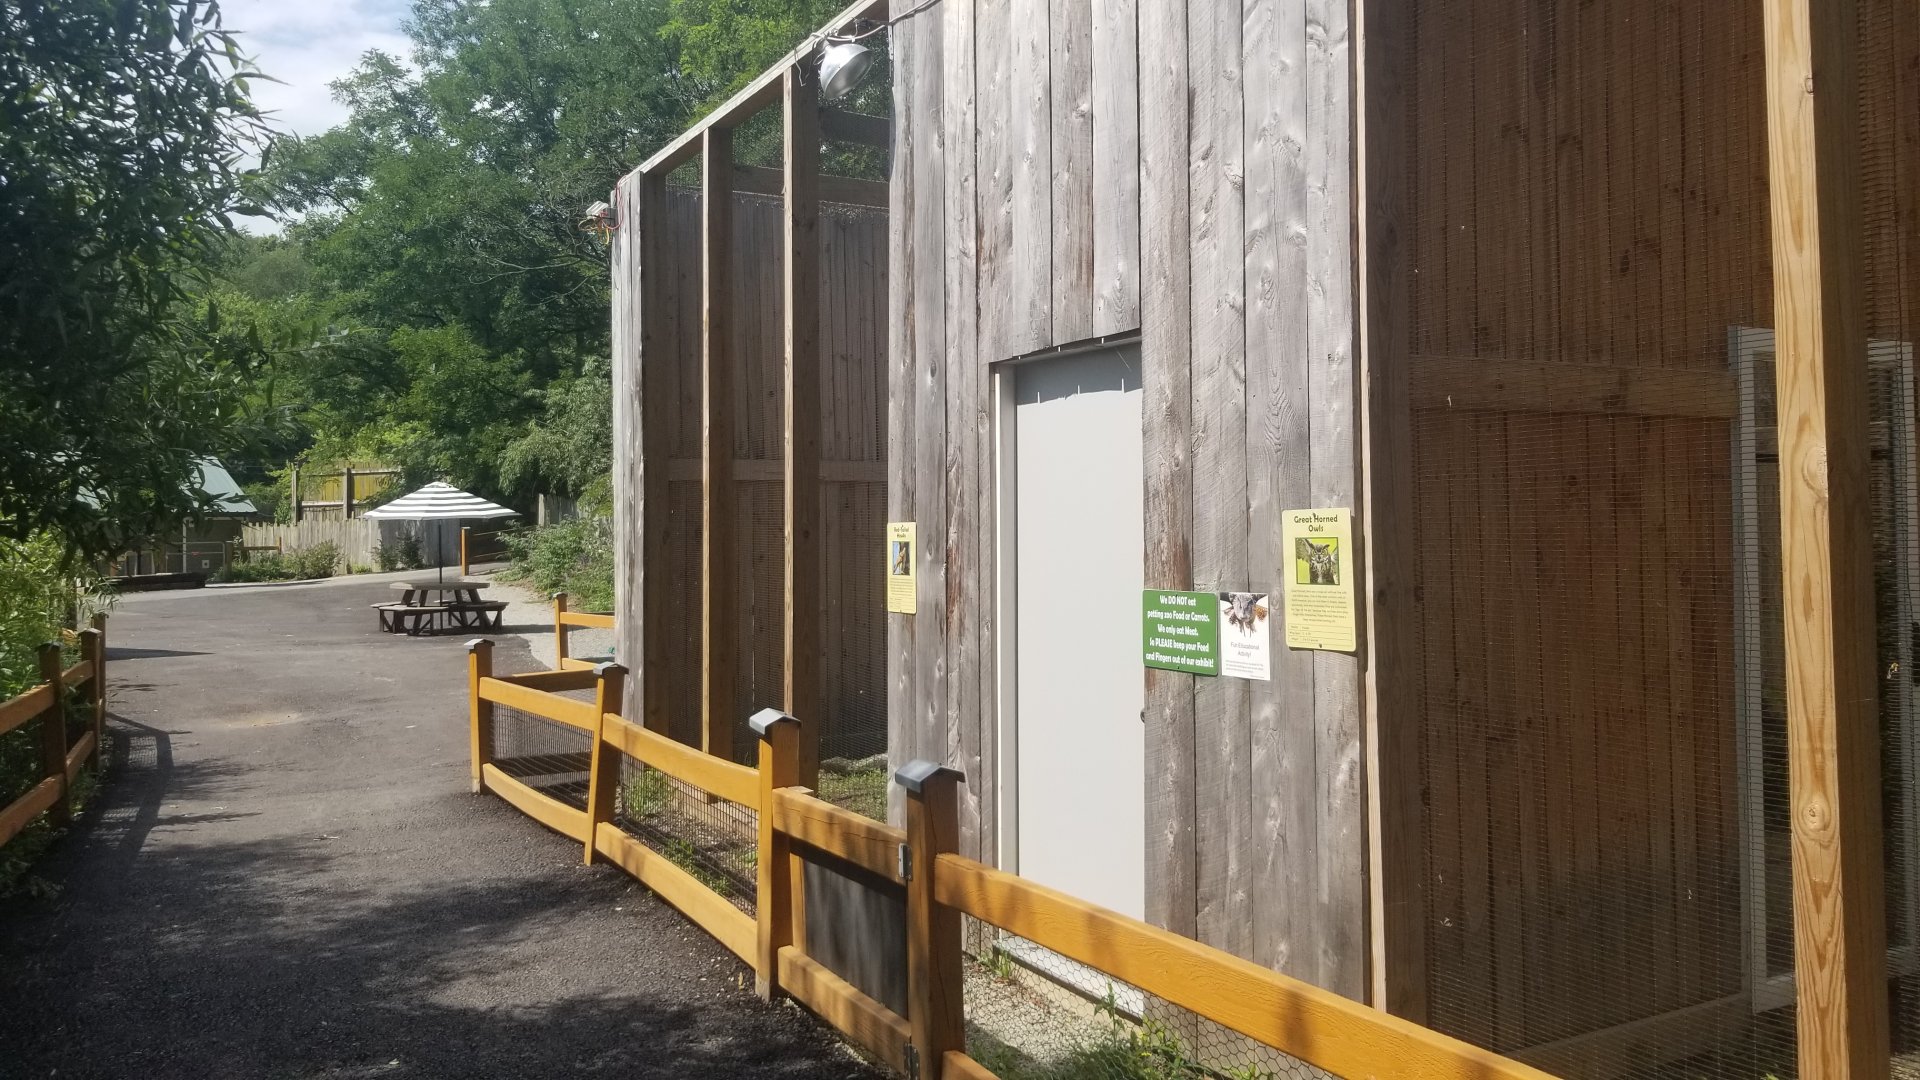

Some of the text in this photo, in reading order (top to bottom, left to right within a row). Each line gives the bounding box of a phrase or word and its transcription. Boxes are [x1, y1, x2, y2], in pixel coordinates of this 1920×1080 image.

[1294, 514, 1338, 524] Great Horned
[1308, 524, 1324, 532] Owls
[1160, 595, 1167, 604] We
[1168, 596, 1176, 604] DO
[1177, 596, 1187, 605] NOT
[1147, 610, 1163, 619] petting
[1173, 611, 1184, 620] Food
[1191, 612, 1210, 622] Carrots.
[1158, 624, 1166, 632] We
[1166, 625, 1176, 635] only
[1185, 626, 1198, 636] Meat.
[1150, 638, 1209, 652] So PLEASE keep your Food
[1156, 652, 1172, 663] Fingers
[1172, 656, 1180, 664] out
[1181, 655, 1186, 664] of
[1195, 658, 1214, 668] exhibit!
